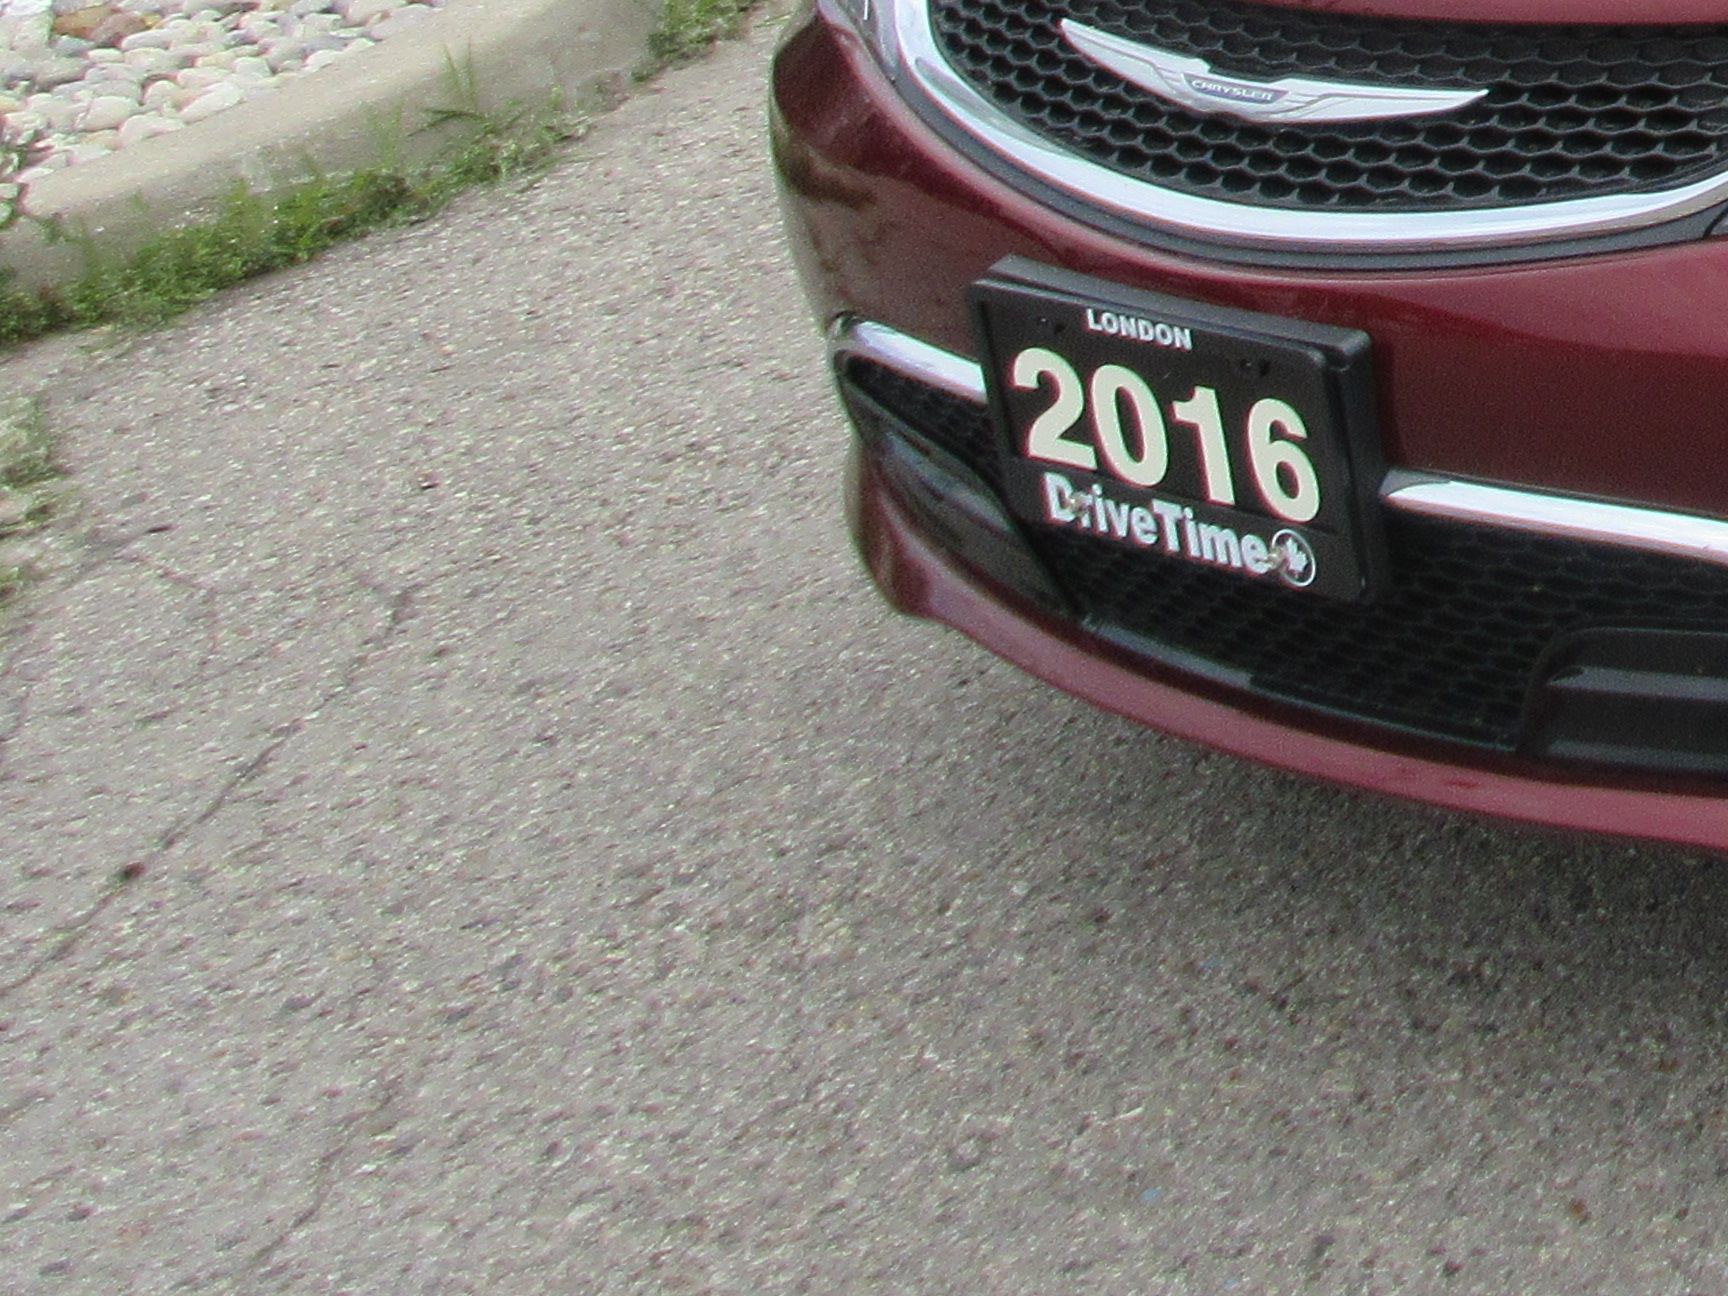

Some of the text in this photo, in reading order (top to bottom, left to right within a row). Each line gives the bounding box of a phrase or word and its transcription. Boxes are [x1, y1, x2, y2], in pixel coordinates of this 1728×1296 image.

[1190, 79, 1273, 101] CHRYSLER
[1087, 307, 1193, 351] LONDON
[1009, 346, 1321, 525] 2016
